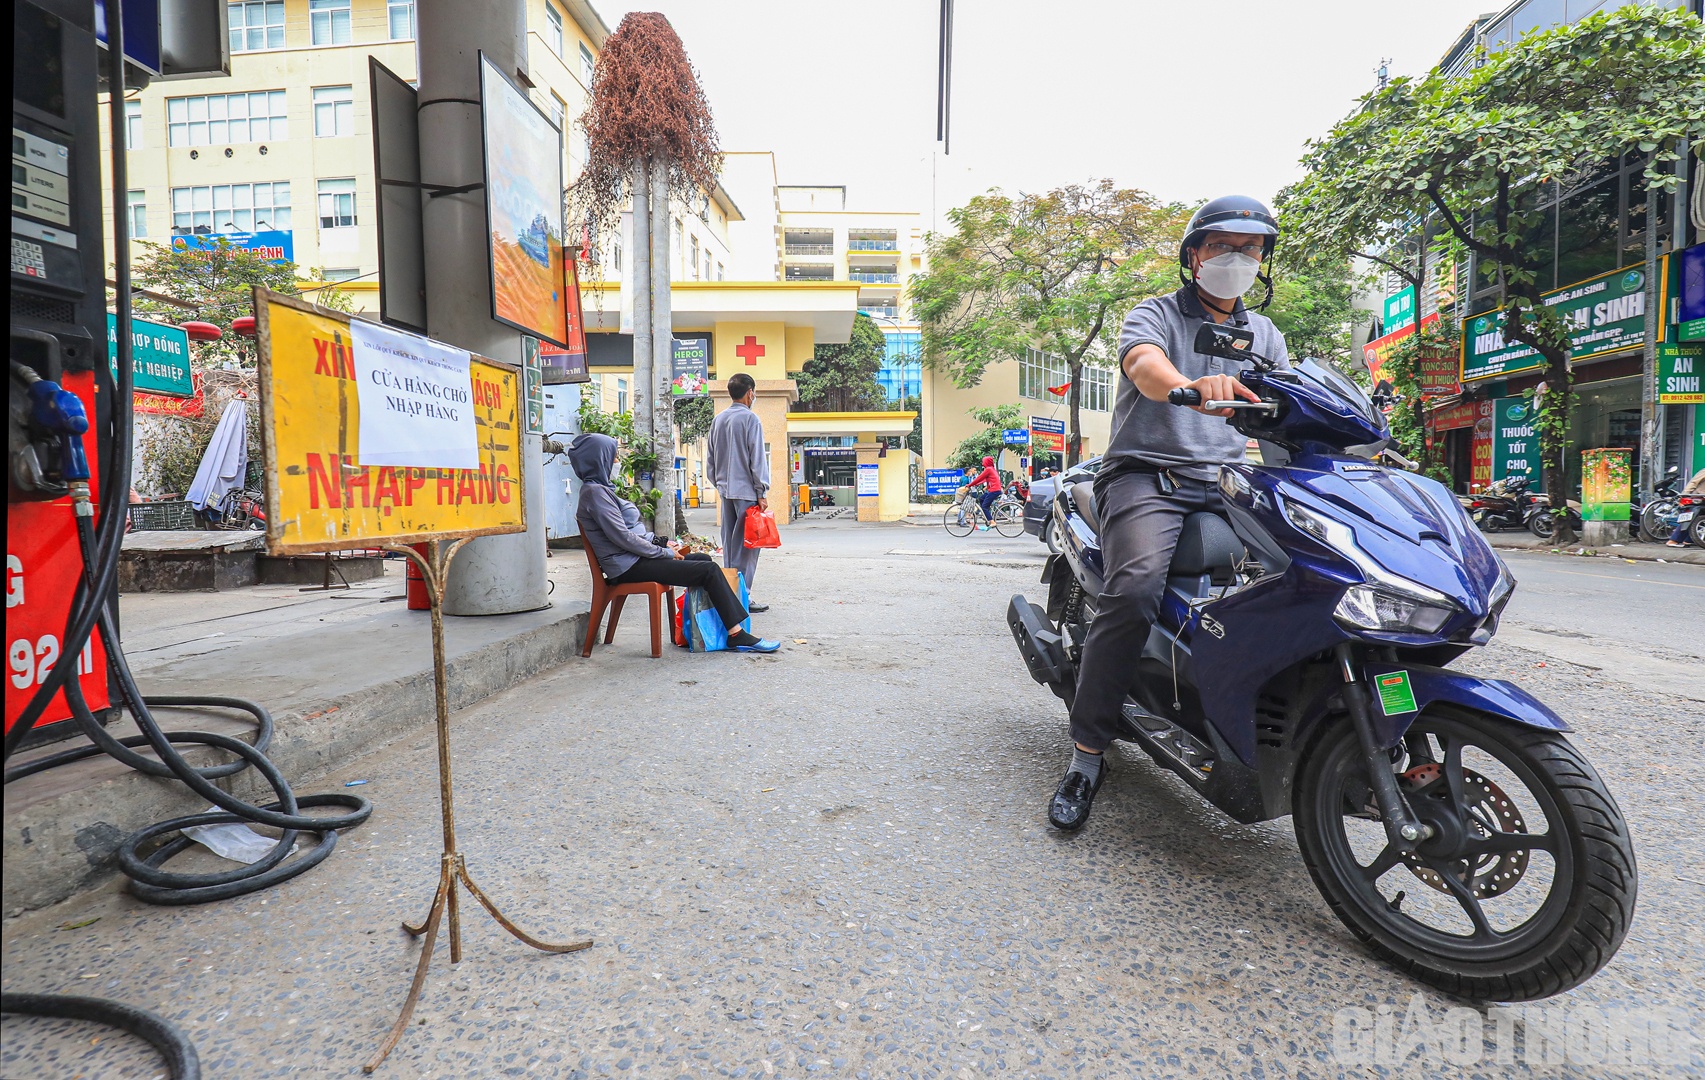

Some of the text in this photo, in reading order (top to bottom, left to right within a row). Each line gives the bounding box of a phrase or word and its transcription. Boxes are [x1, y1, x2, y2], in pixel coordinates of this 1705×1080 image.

[30, 147, 47, 158] WON
[31, 176, 55, 189] LITERS
[1570, 288, 1583, 300] AN
[1583, 281, 1607, 295] SINH
[1594, 292, 1645, 327] SINH
[153, 335, 181, 355] ĐỒNG
[1664, 345, 1702, 356] NHÀ THUỐC
[313, 337, 356, 382] XIN
[674, 349, 704, 359] HEROS
[146, 362, 184, 382] NGHIỆP
[1673, 358, 1693, 373] AN
[371, 368, 468, 404] CỬA HÀNG CHỜ
[1666, 376, 1700, 393] SINH
[386, 395, 459, 422] NHẬP HÀNG
[1502, 423, 1534, 438] THUỐC
[1508, 440, 1527, 454] TỐT
[1506, 459, 1528, 470] CHO
